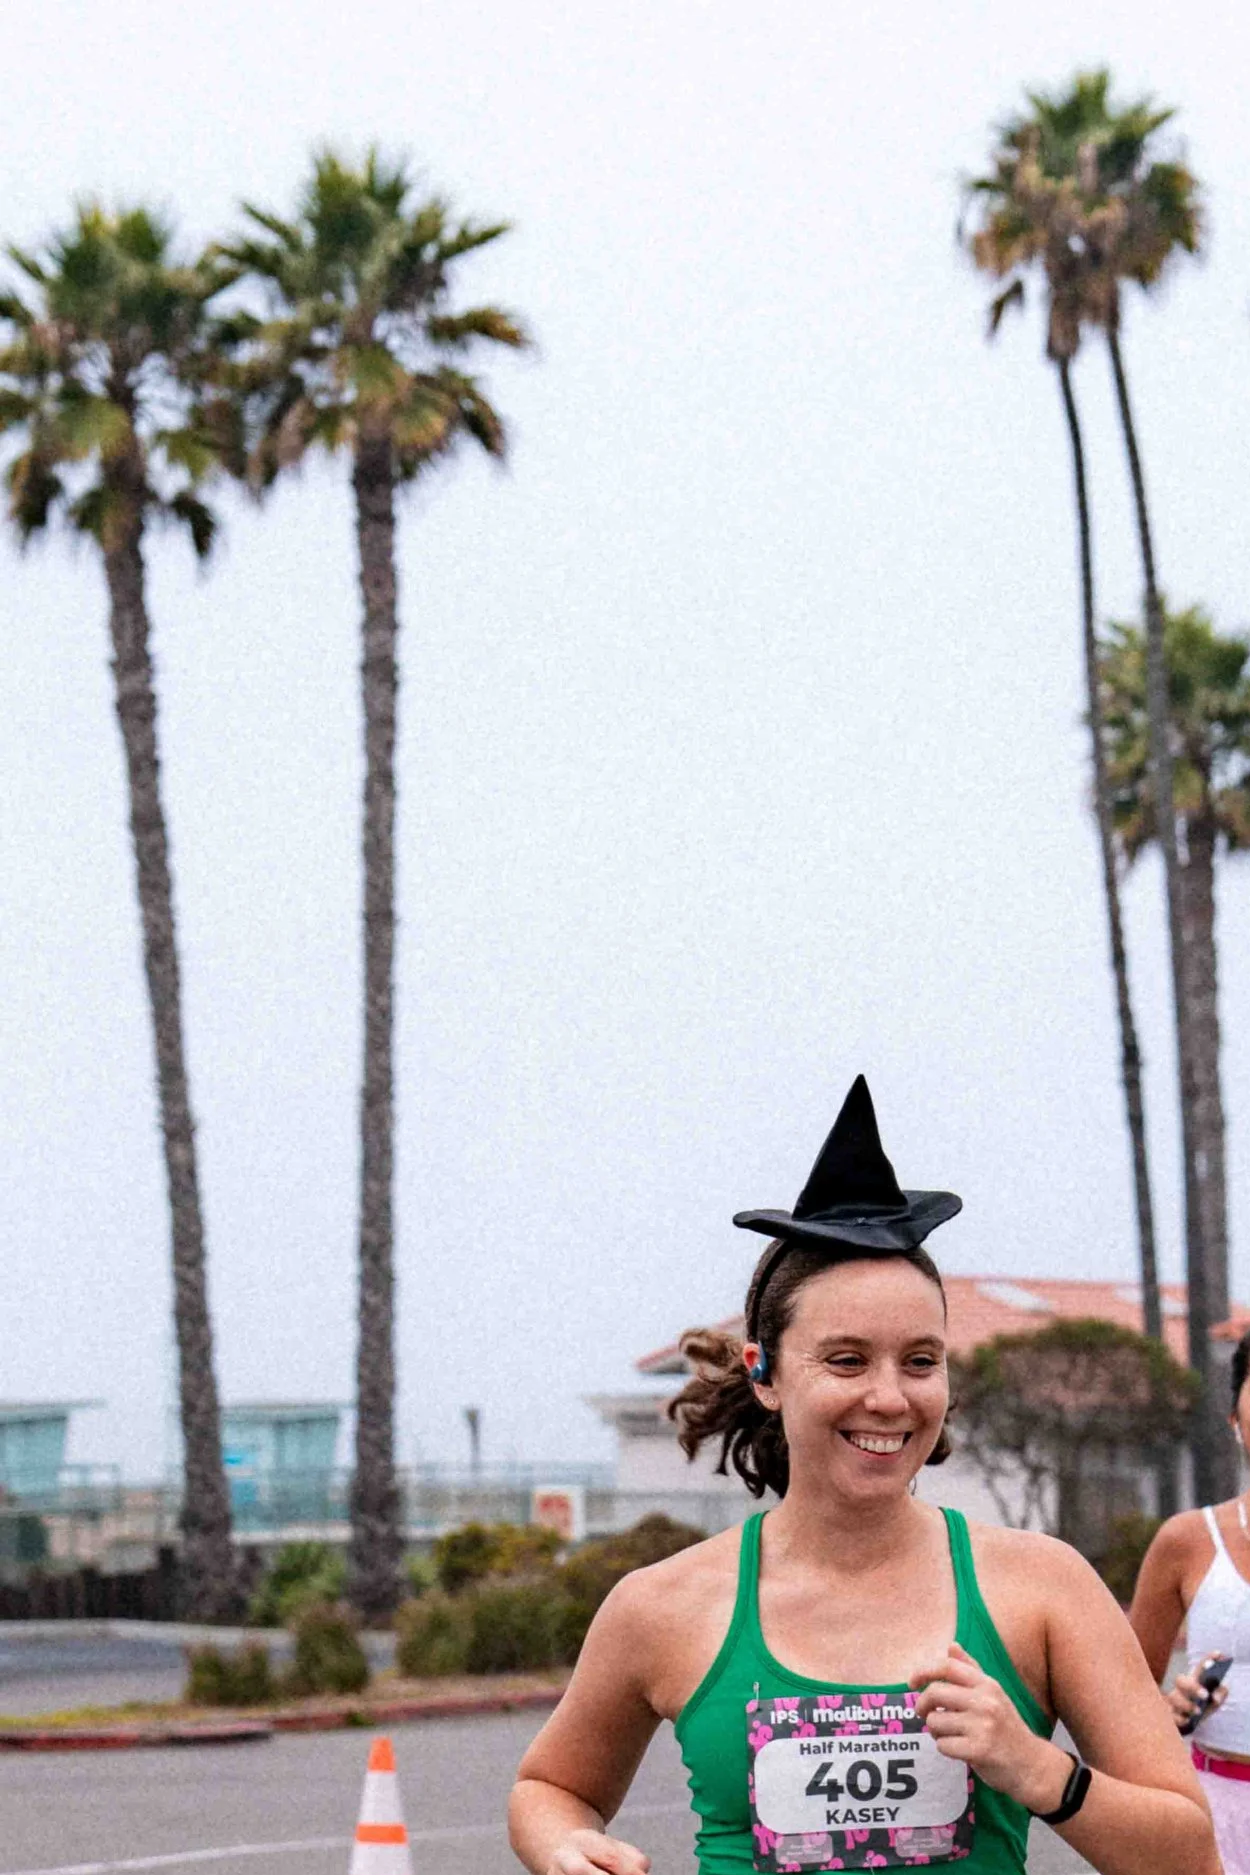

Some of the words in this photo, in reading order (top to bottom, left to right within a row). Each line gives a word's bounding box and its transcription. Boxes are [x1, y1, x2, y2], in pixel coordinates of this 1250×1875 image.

[770, 1709, 799, 1724] IPS
[799, 1741, 834, 1755] Half
[839, 1739, 920, 1753] Marathon
[805, 1759, 918, 1802] 405
[826, 1807, 900, 1825] KASEY
